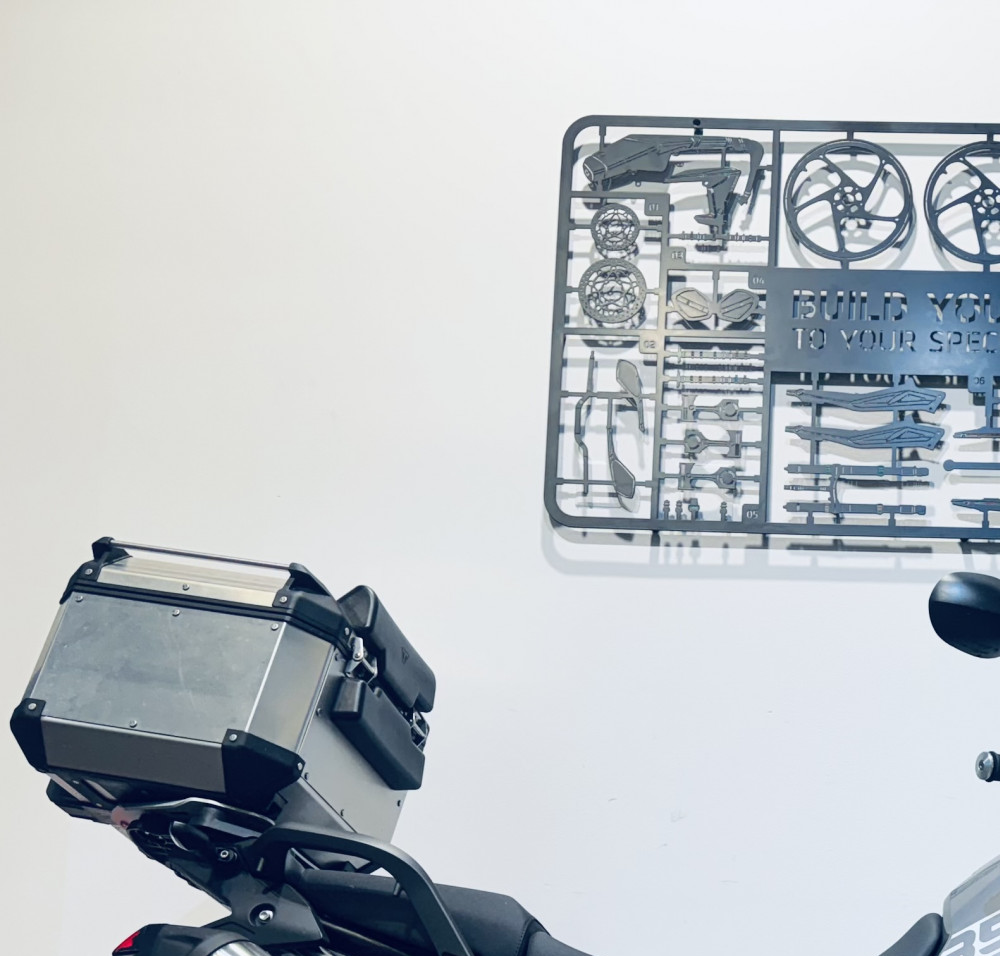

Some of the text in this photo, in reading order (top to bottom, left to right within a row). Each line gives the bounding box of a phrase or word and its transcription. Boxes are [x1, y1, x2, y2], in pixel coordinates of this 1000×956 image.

[791, 288, 909, 321] BUILD
[792, 327, 827, 350] TO
[840, 328, 917, 353] YOUR
